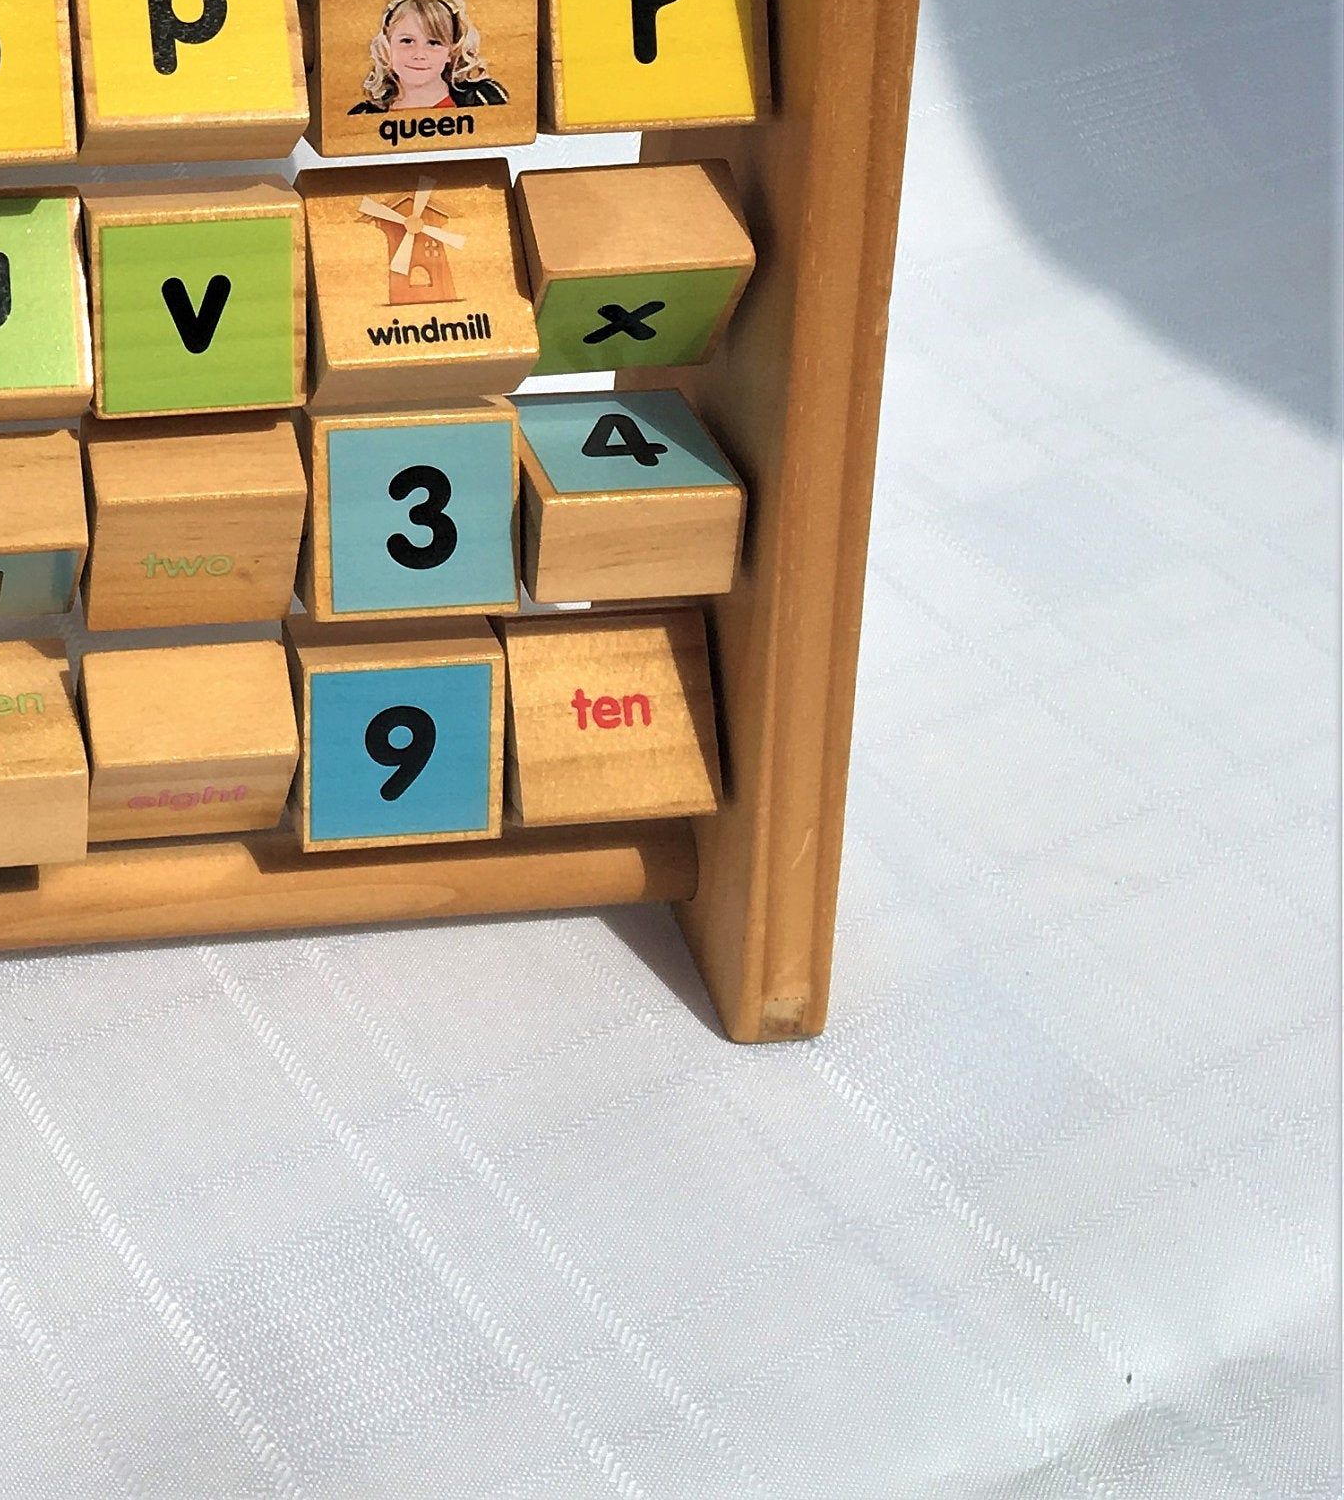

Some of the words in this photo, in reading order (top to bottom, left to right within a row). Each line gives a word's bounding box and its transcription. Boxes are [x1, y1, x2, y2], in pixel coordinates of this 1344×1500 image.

[378, 112, 475, 146] queen
[161, 274, 232, 354] v
[367, 314, 492, 347] windmill
[583, 300, 666, 344] x
[581, 413, 668, 467] 4
[387, 465, 458, 570] 3
[140, 552, 234, 578] two
[572, 689, 652, 731] ten
[364, 705, 437, 801] 9
